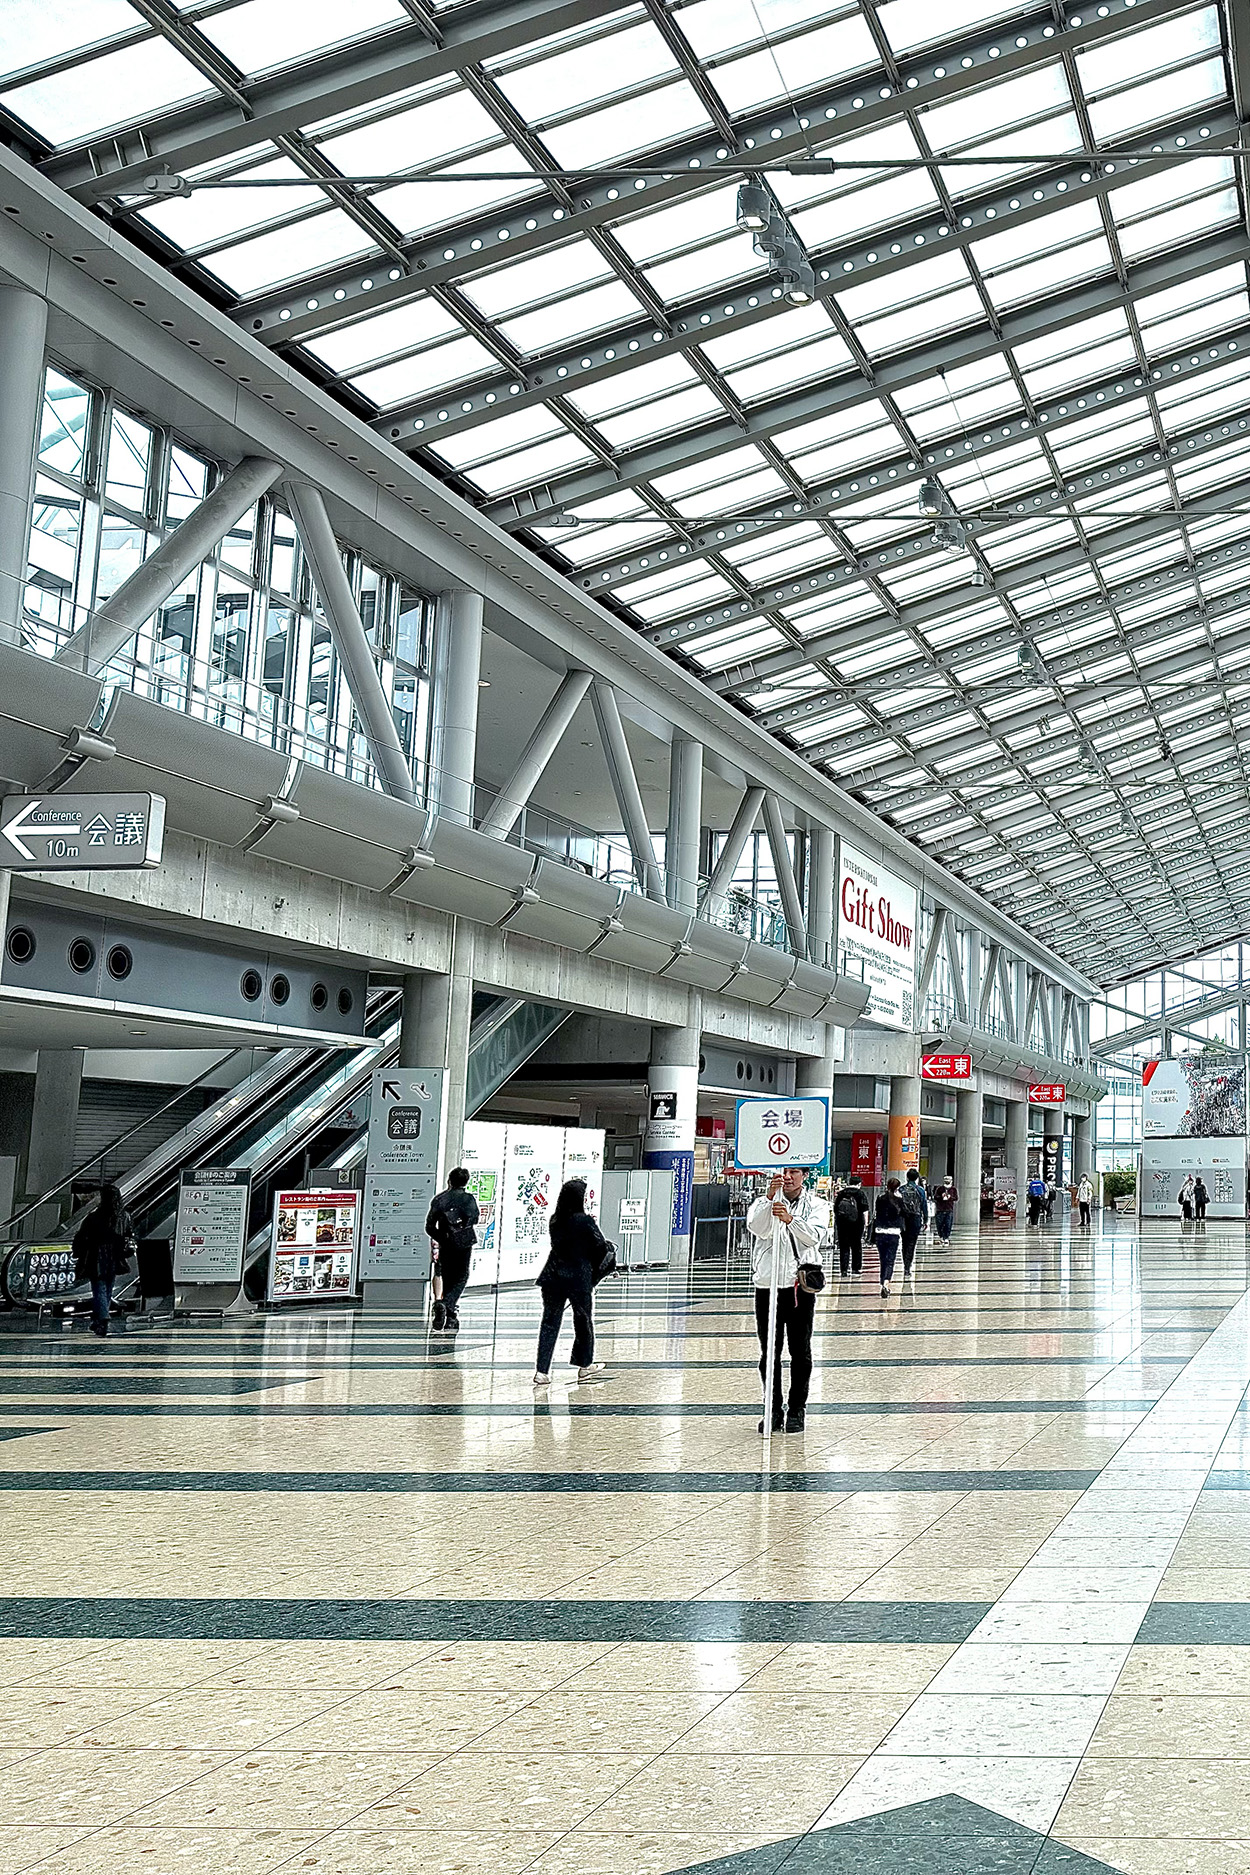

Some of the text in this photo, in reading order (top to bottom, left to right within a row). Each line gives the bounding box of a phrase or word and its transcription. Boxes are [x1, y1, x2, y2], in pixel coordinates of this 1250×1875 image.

[31, 809, 82, 822] Conference
[83, 812, 145, 846] 会議
[46, 840, 79, 857] 10m
[842, 877, 913, 952] Gift Show
[953, 1057, 969, 1075] 東
[1052, 1086, 1063, 1100] 東
[391, 1109, 420, 1117] Conference
[761, 1109, 803, 1128] 会場
[390, 1119, 418, 1135] 会議
[858, 1145, 869, 1159] 東
